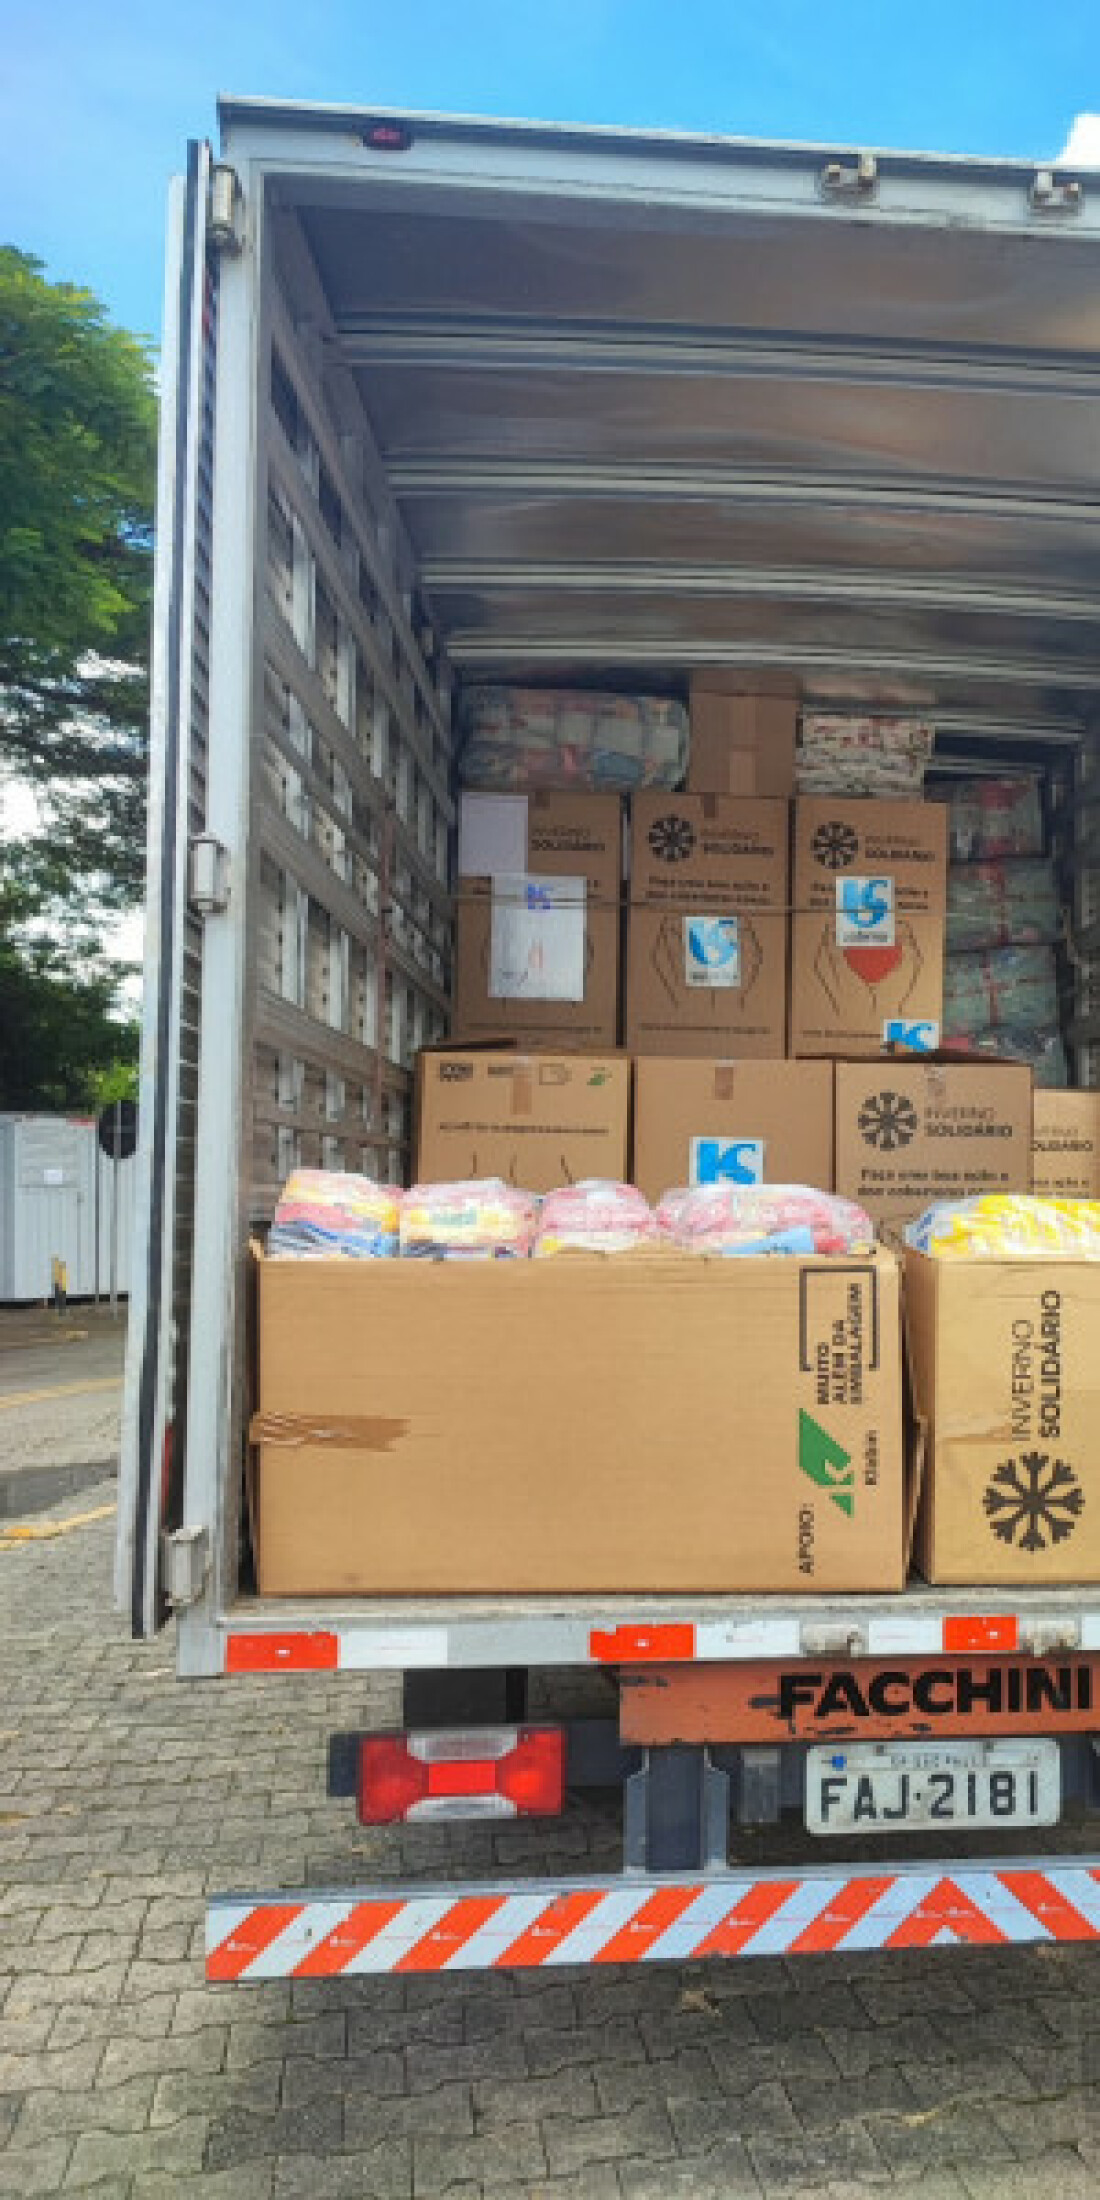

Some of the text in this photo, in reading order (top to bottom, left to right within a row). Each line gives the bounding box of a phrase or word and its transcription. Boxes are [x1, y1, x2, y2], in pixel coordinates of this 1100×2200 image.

[816, 1341, 831, 1406] MUITO
[1011, 1318, 1035, 1442] INVERNO
[1035, 1289, 1061, 1439] SOLIDÁRIO
[778, 1667, 1091, 1719] FACCHINI
